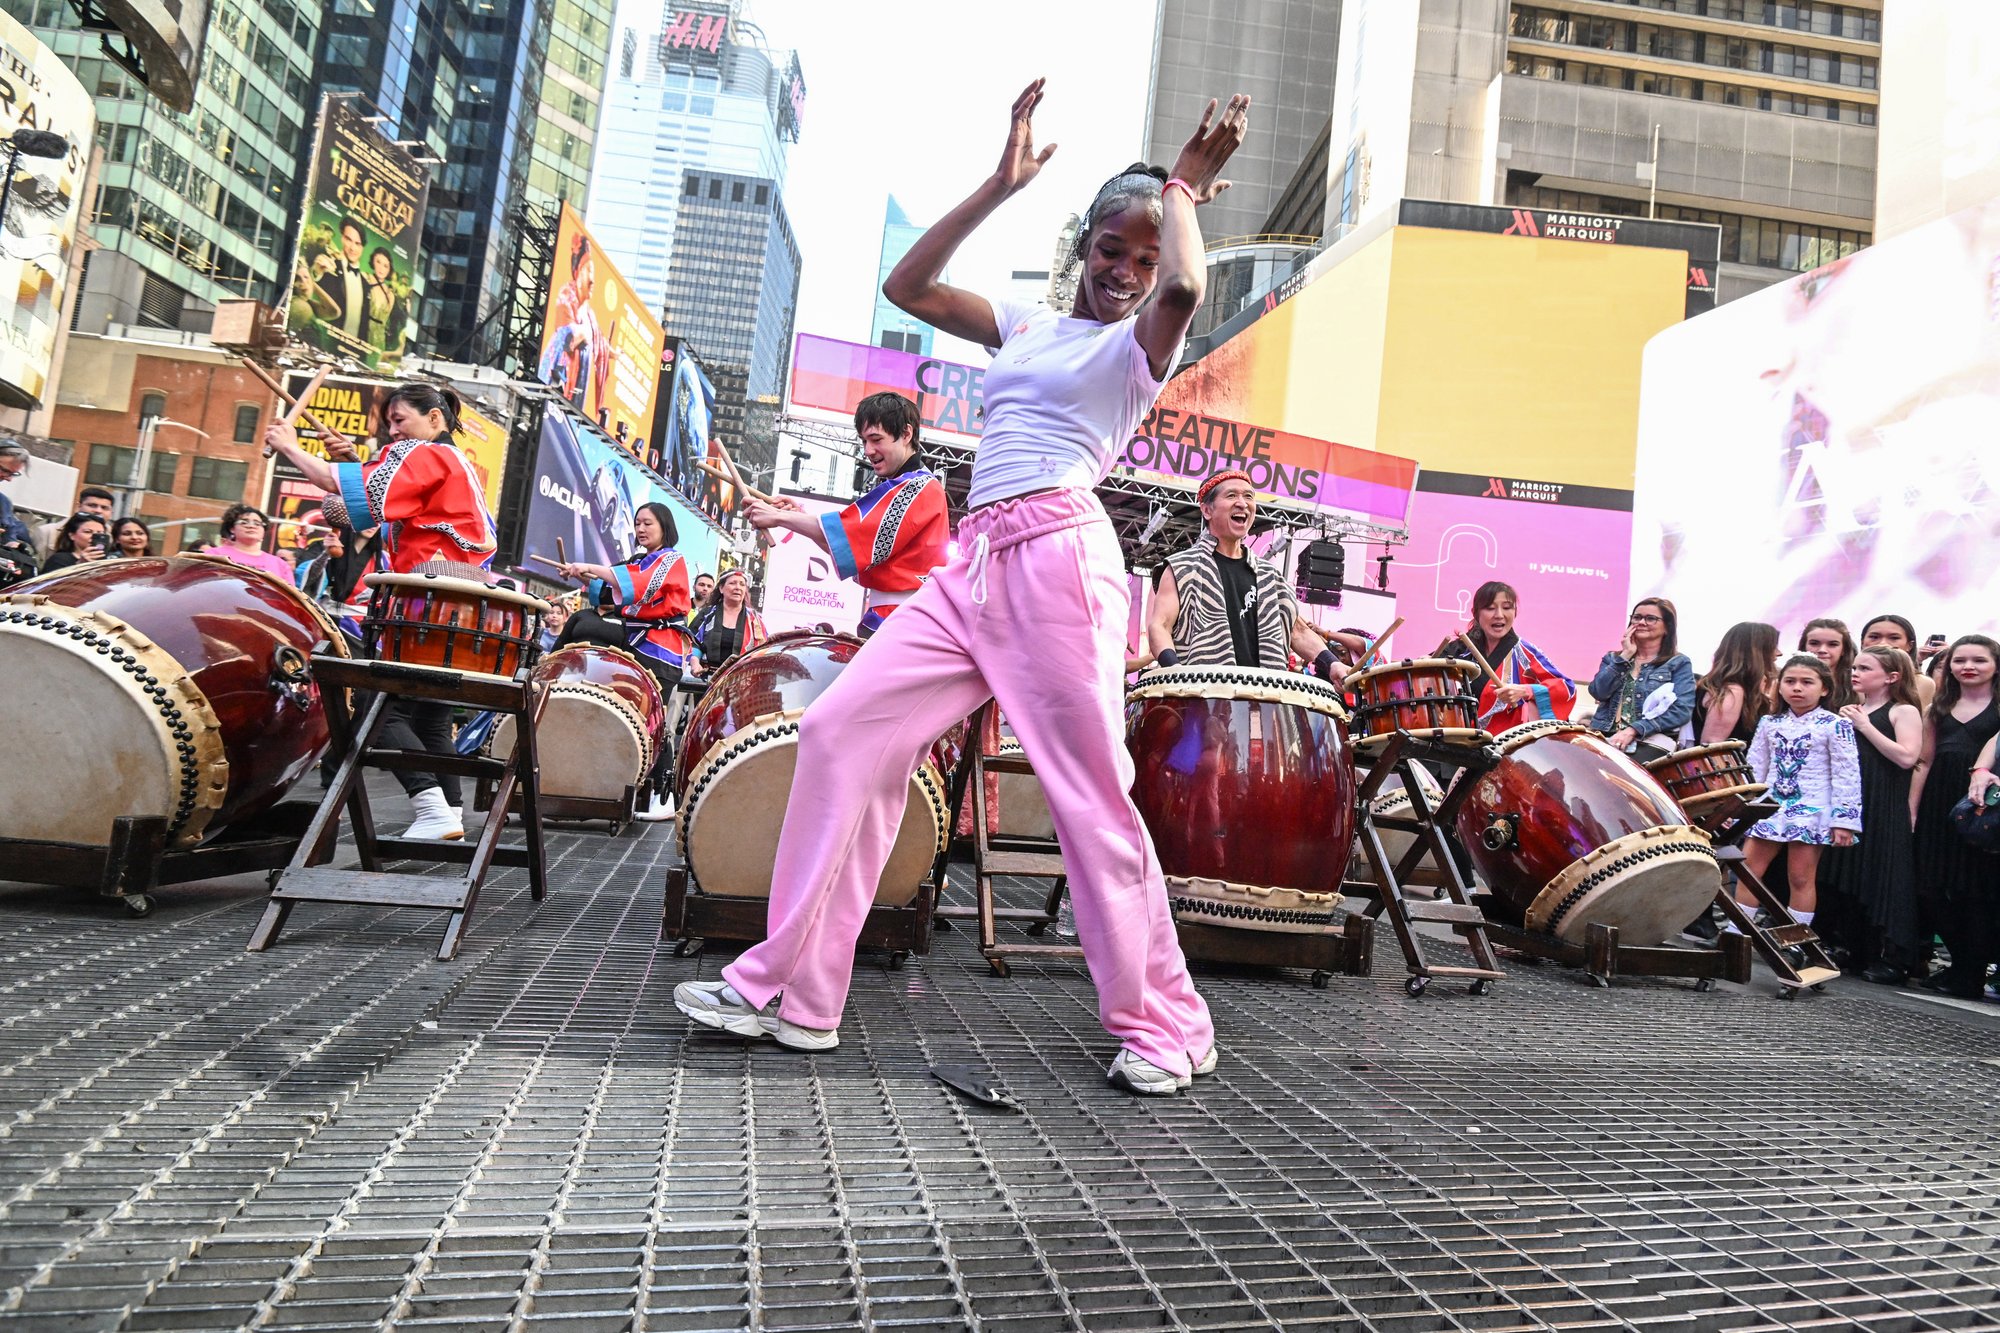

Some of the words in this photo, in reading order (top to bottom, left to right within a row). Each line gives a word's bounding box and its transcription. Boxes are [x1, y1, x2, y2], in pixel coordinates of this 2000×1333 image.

[664, 12, 727, 54] H&M
[337, 184, 405, 237] GATSBY
[363, 179, 416, 228] GREAT
[1547, 214, 1623, 230] MARRIOTT
[1546, 226, 1613, 241] MARQUIS
[1688, 285, 1715, 293] MARRIOTT
[660, 363, 672, 372] LG
[916, 360, 985, 402] CRE
[1134, 406, 1275, 461] REATIVE
[1116, 434, 1320, 499] ONDITIONS
[1511, 489, 1557, 501] MARQUIS
[1512, 481, 1564, 493] MARRIOTT
[548, 482, 592, 520] ACURA
[783, 593, 845, 609] FOUNDATION
[784, 585, 812, 597] DORIS
[813, 589, 839, 601] DUKE
